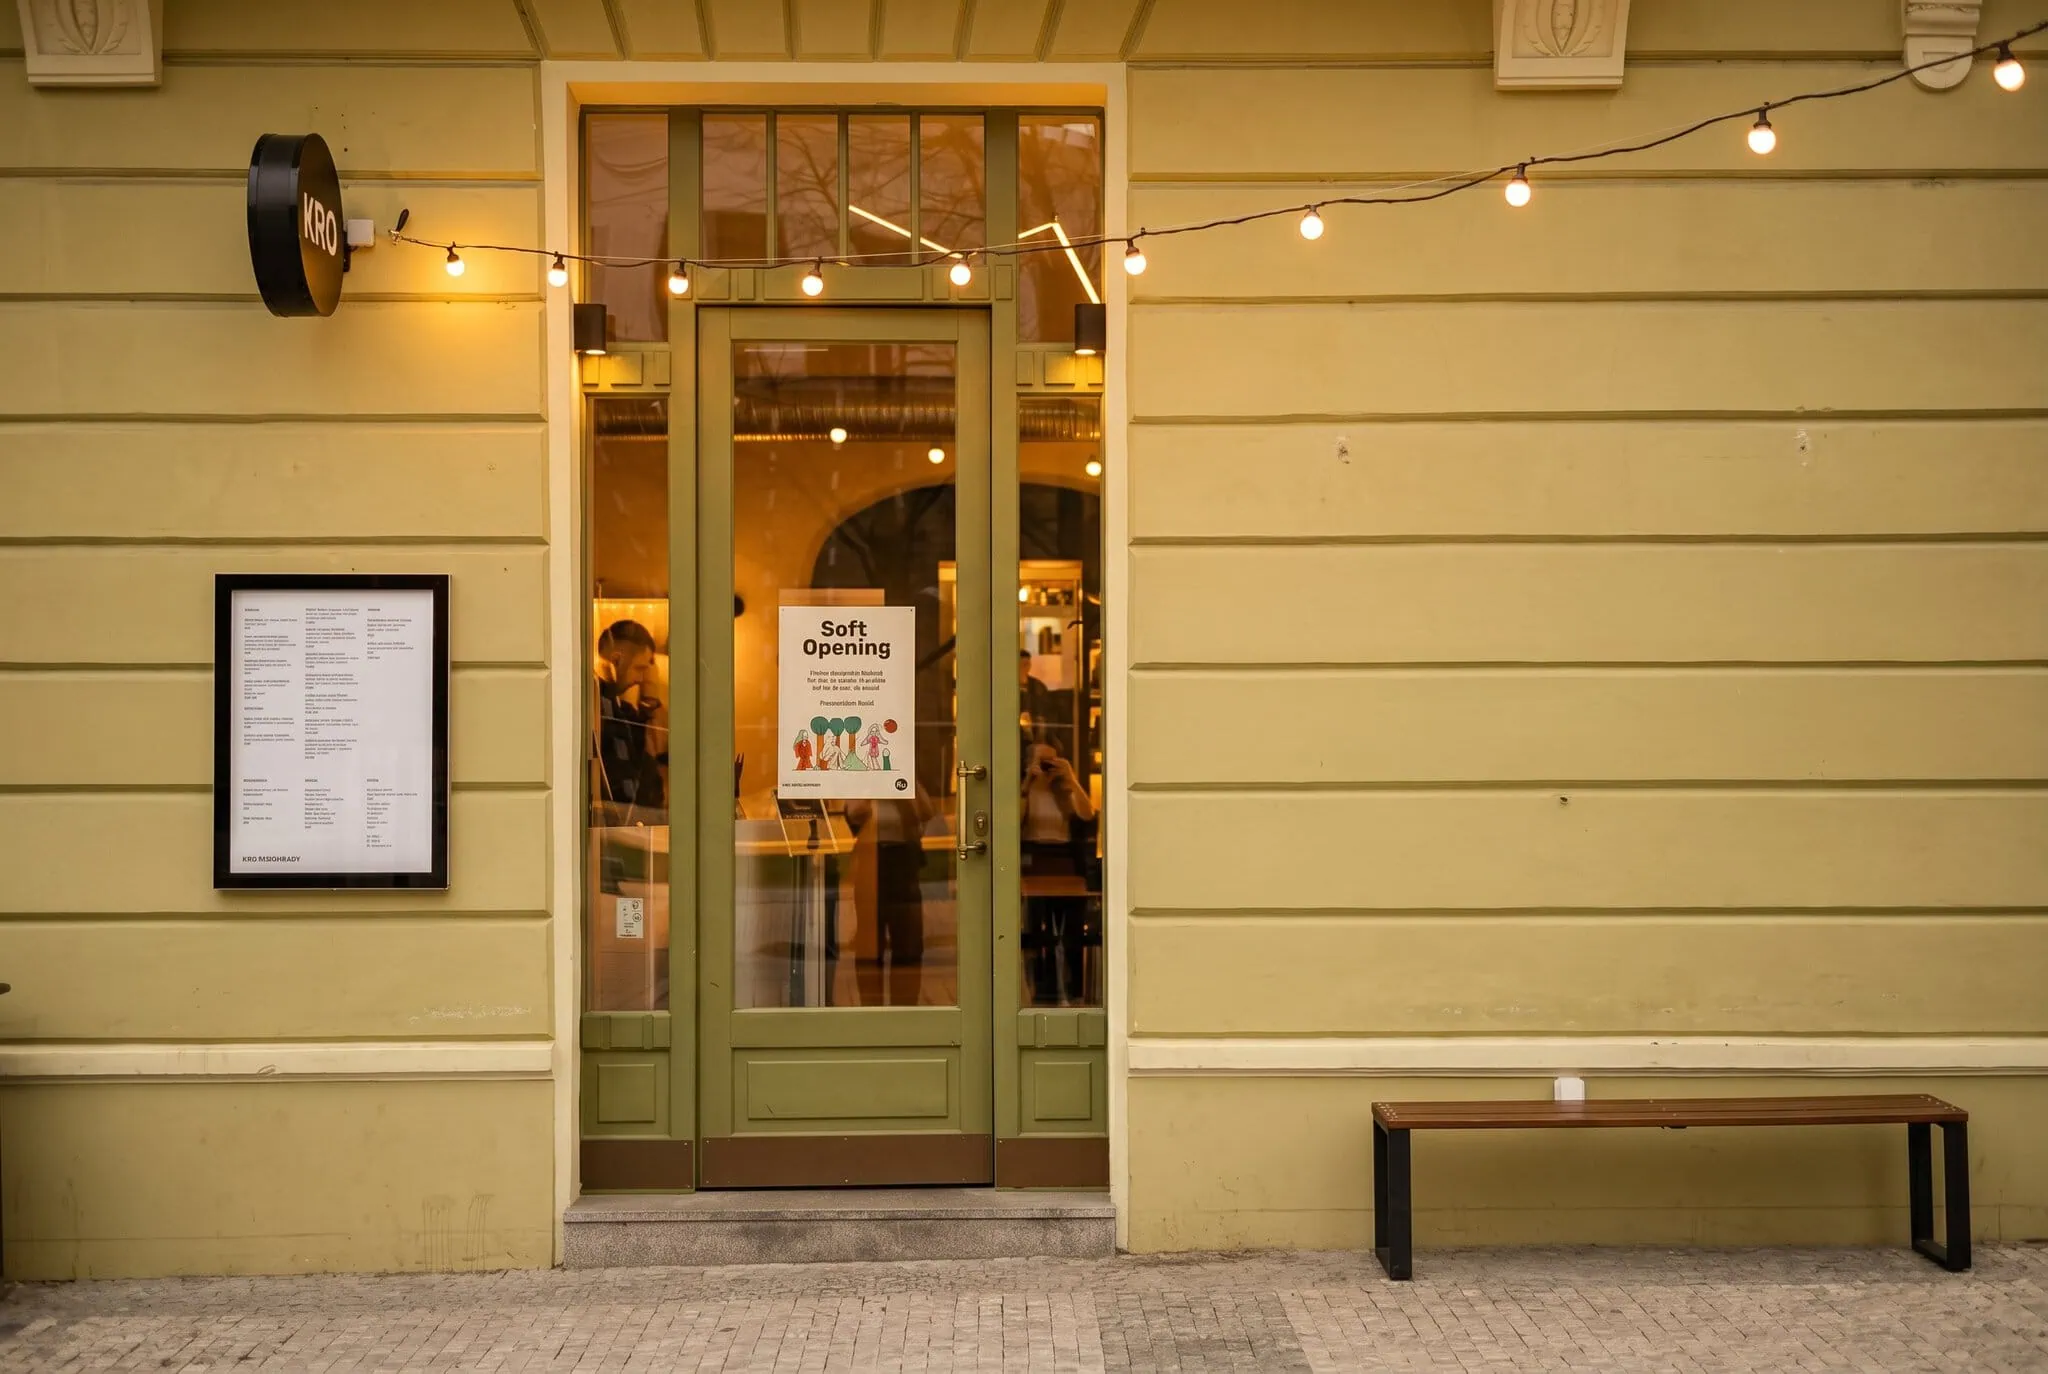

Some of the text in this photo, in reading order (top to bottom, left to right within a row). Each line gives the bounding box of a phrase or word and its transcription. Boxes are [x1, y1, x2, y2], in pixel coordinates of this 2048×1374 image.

[303, 192, 338, 256] KRO
[820, 620, 867, 637] Soft
[803, 638, 891, 659] Opening
